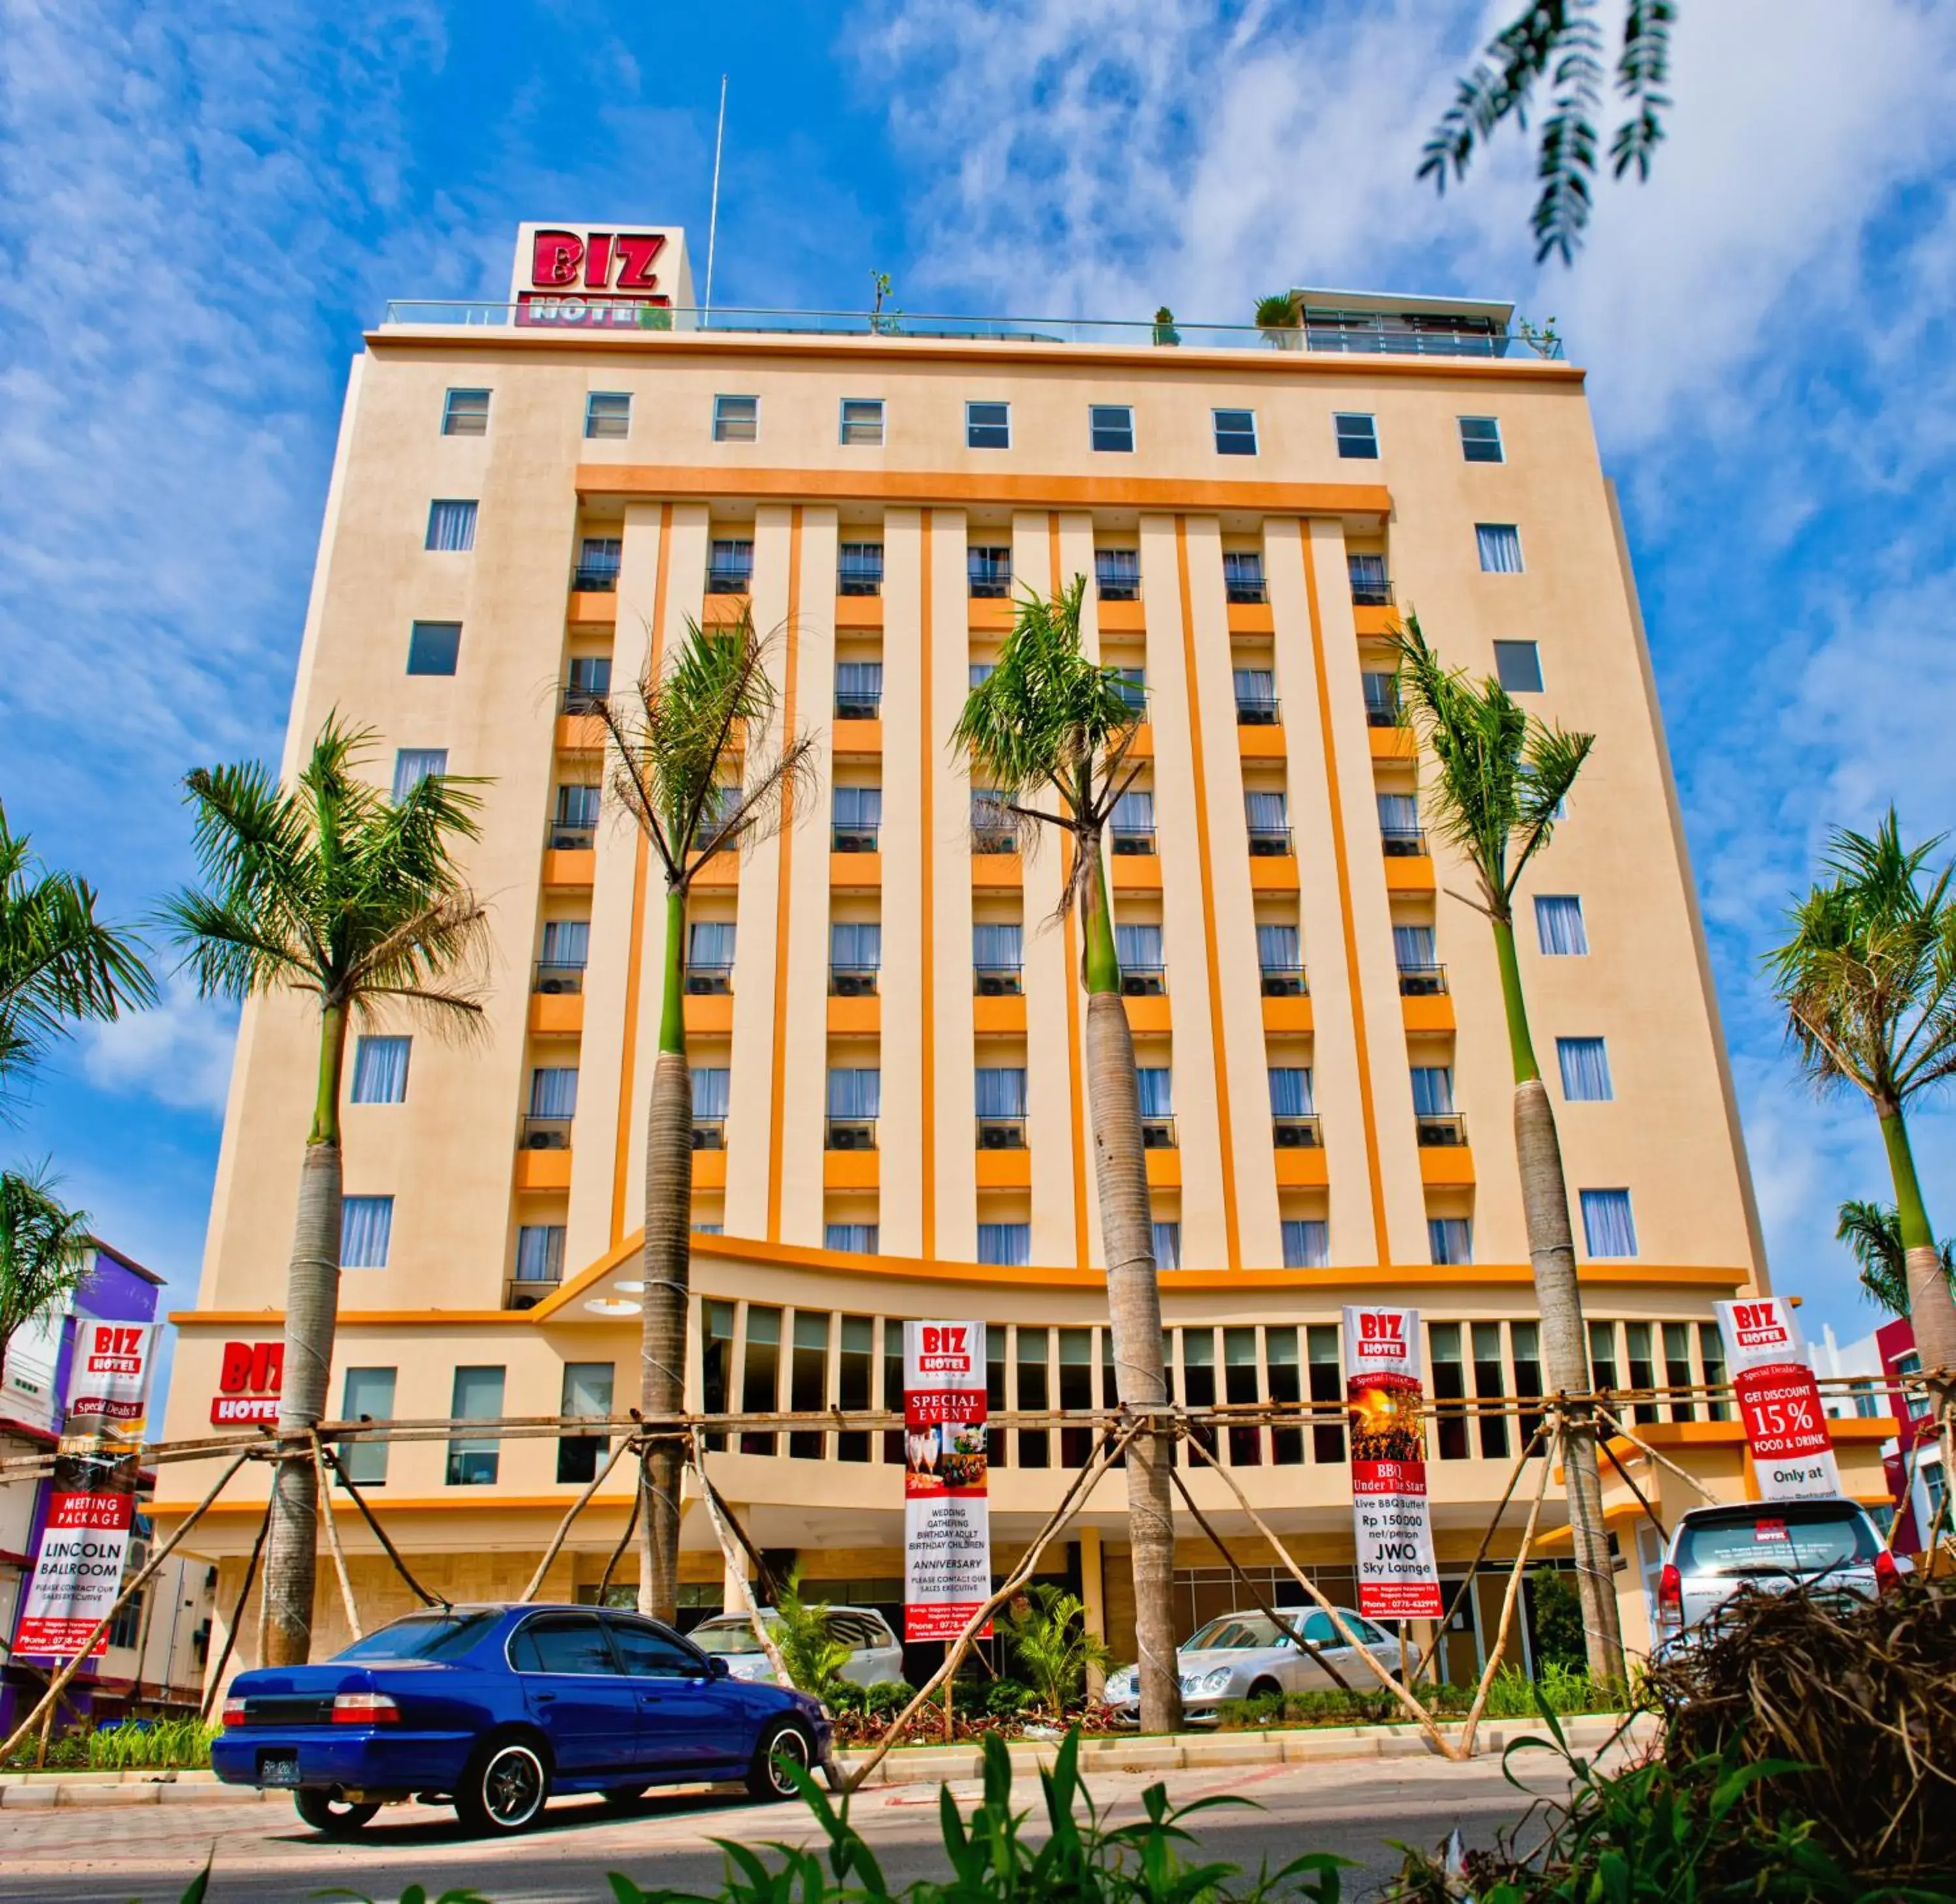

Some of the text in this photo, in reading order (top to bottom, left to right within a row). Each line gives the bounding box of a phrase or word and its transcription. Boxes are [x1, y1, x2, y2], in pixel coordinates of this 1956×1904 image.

[532, 230, 666, 288] BIZ
[1732, 1303, 1778, 1330] BIZ
[1360, 1313, 1402, 1339] BIZ
[95, 1327, 143, 1354] BIZ
[923, 1327, 968, 1353] BIZ
[1741, 1330, 1783, 1345] HOTEL
[1363, 1344, 1402, 1356] HOTEL
[93, 1358, 135, 1371] HOTEL
[925, 1358, 966, 1369] HOTEL
[1745, 1385, 1811, 1403] GET DISCOUNT
[78, 1401, 106, 1413] Special
[912, 1395, 979, 1407] SPECIAL
[919, 1408, 972, 1421] EVENT
[1752, 1400, 1813, 1435] 15%
[1754, 1434, 1825, 1453] FOOD & DRINK
[1377, 1464, 1402, 1479] BBQ
[1773, 1466, 1823, 1483] Only at
[1354, 1480, 1425, 1492] Under The Star
[65, 1498, 117, 1511] MEETING
[1356, 1498, 1425, 1509] Live BBQ Buffet
[58, 1512, 119, 1525] PACKAGE
[932, 1509, 966, 1517] WEDDING
[928, 1519, 968, 1528] GATHERING
[1362, 1515, 1378, 1528] Rp
[917, 1530, 979, 1539] BIRTHDAY ADULT
[1369, 1530, 1418, 1540] net/person
[45, 1543, 121, 1558] LINCOLN
[909, 1541, 985, 1551] BIRTHDAY CHILDREN
[1376, 1543, 1417, 1561] JWO
[40, 1563, 117, 1576] BALLROOM
[913, 1559, 982, 1569] ANNIVERSARY
[1363, 1562, 1430, 1575] Sky Lounge
[941, 1584, 977, 1592] EXECUTIVE
